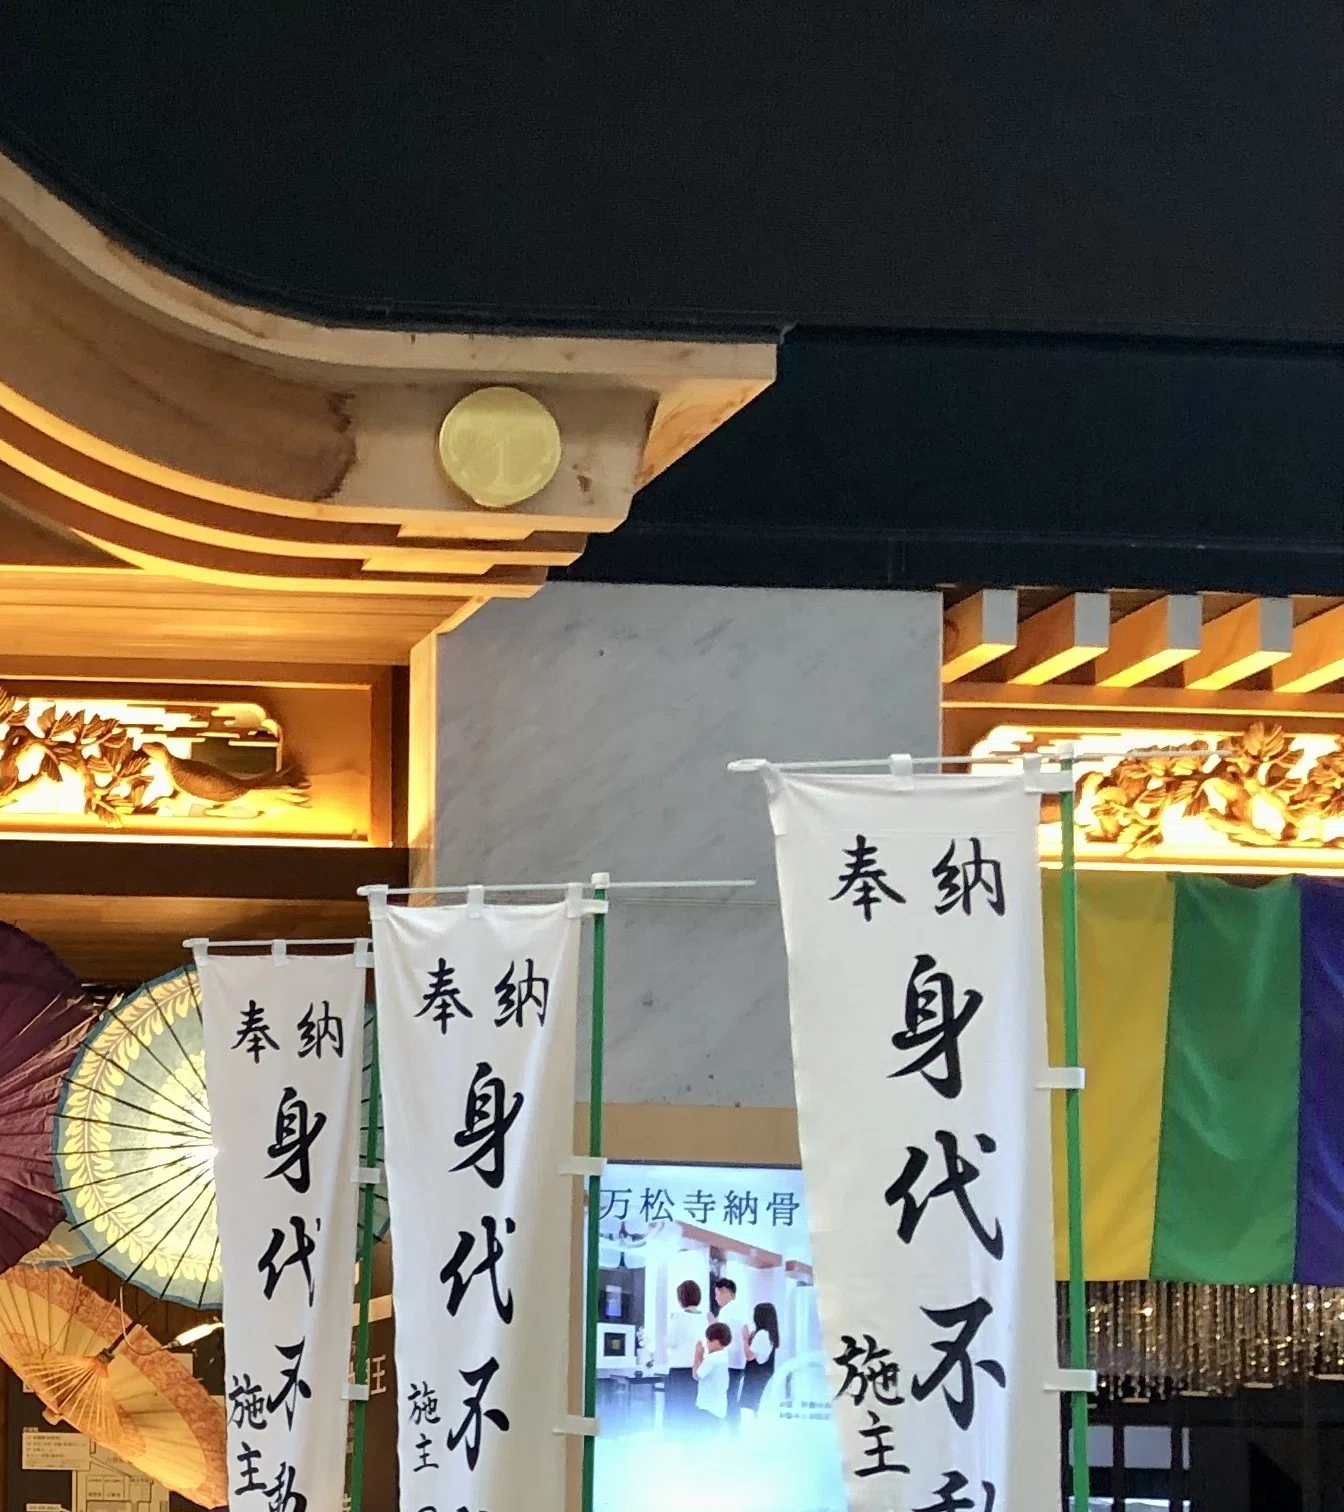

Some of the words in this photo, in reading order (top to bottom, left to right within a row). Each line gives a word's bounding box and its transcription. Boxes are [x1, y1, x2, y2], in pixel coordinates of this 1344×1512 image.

[829, 834, 1007, 922] 奉納
[230, 999, 344, 1064] 奉納
[413, 957, 551, 1035] 奉納
[599, 1187, 800, 1227] 万松寺納骨
